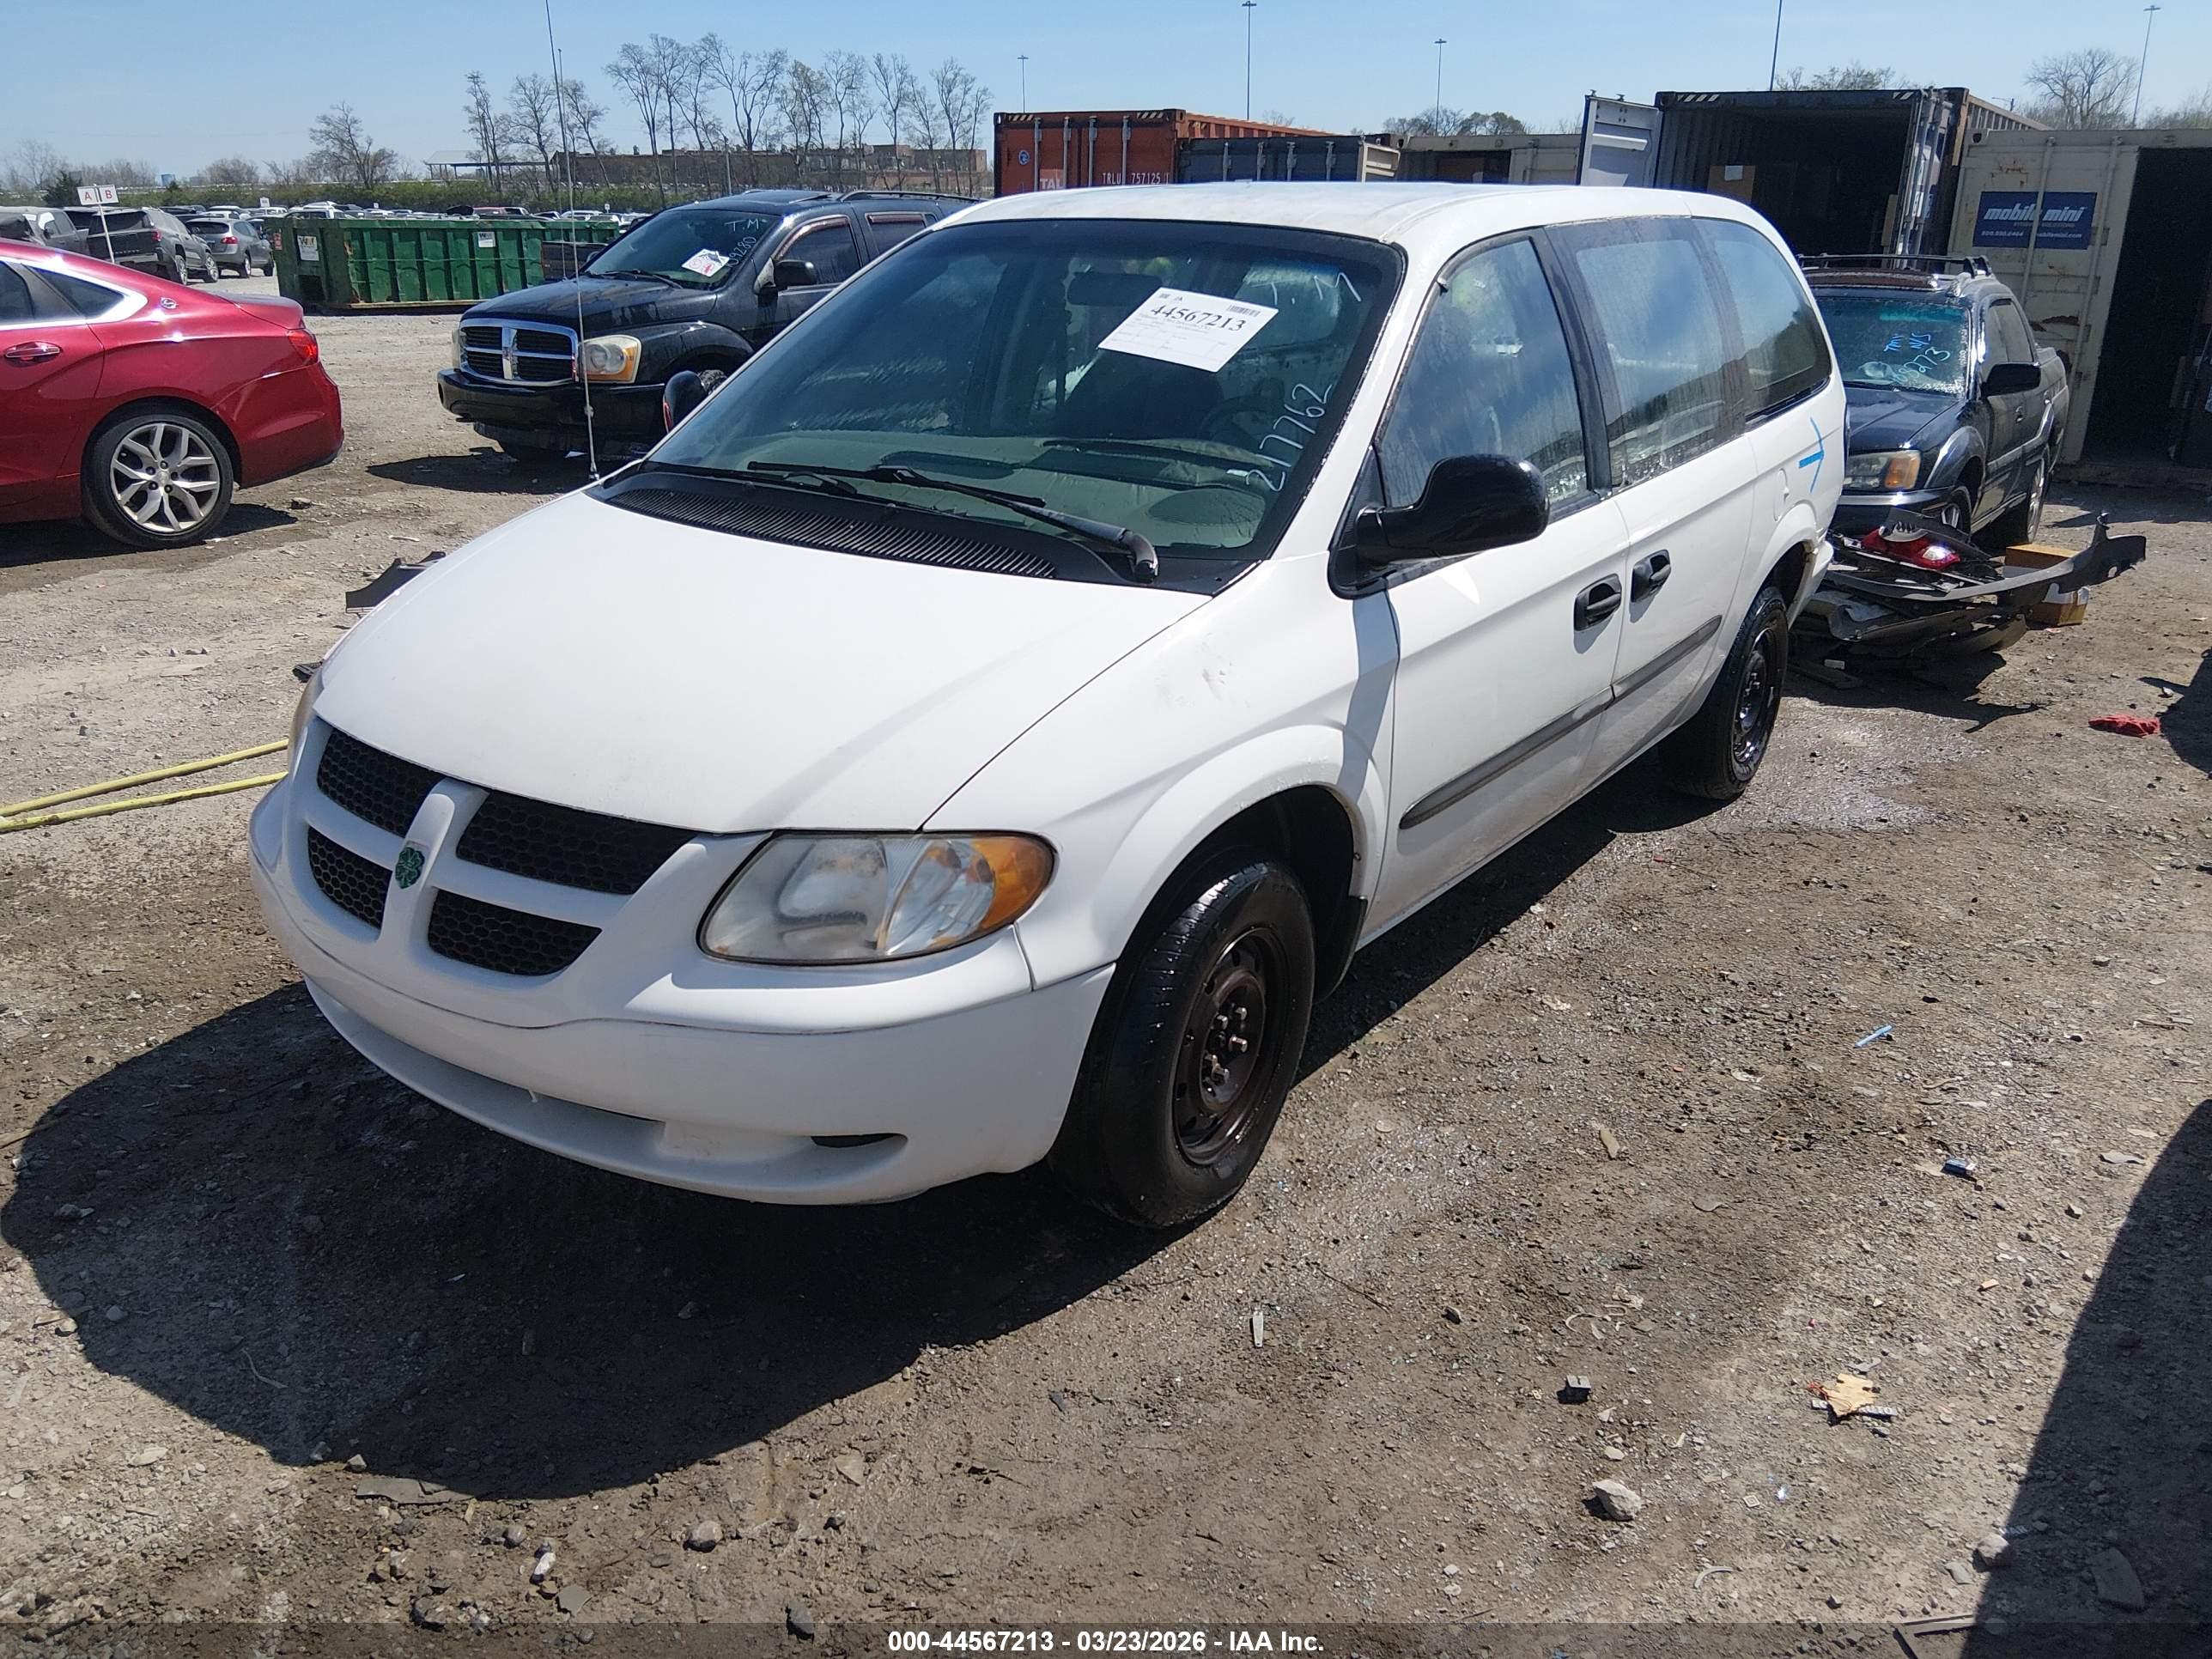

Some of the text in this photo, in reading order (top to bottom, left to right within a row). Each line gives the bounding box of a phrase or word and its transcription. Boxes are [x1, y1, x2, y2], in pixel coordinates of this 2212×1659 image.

[1103, 173, 1121, 185] TRLU
[1131, 173, 1161, 185] 757125
[84, 190, 113, 201] A B
[2042, 206, 2084, 222] mini
[1151, 304, 1247, 332] 44567213
